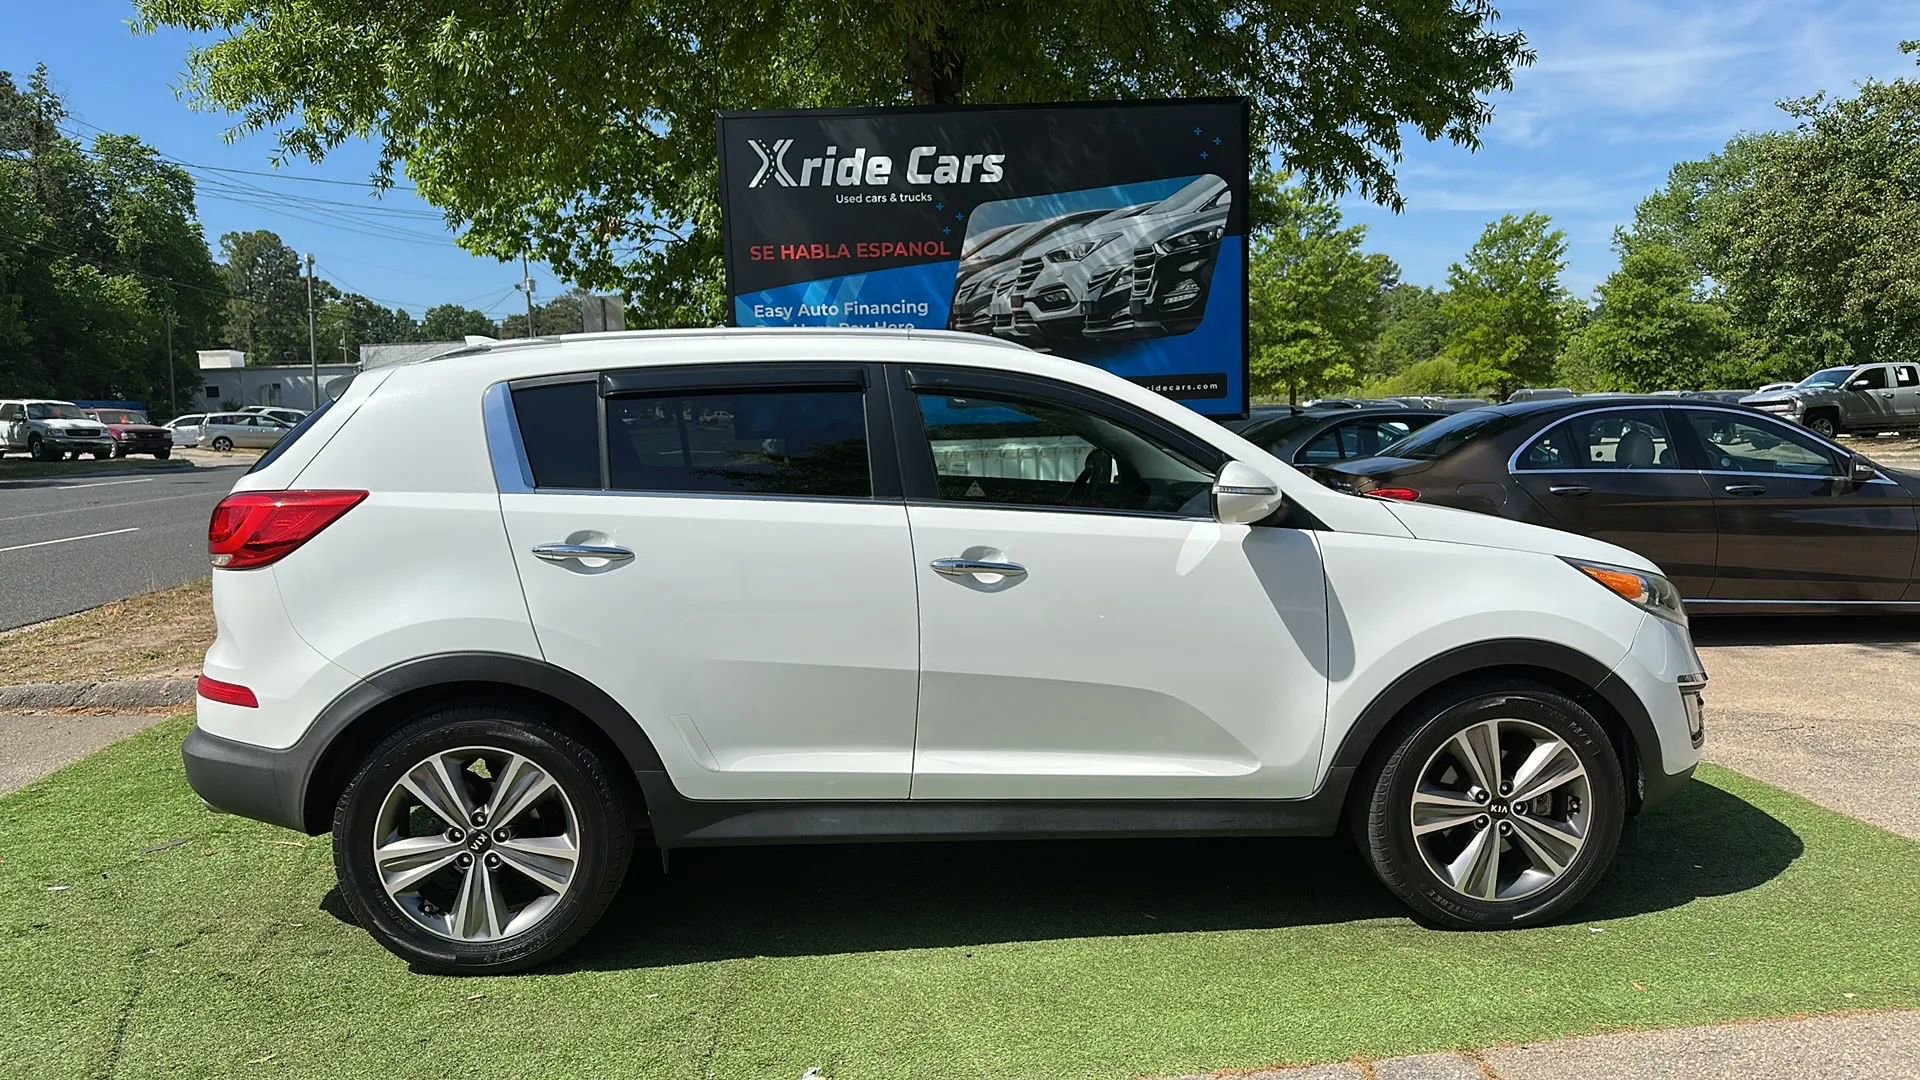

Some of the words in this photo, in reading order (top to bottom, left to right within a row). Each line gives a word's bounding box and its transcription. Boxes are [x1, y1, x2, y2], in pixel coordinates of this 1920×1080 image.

[906, 146, 1006, 185] Cars
[836, 194, 863, 204] Used
[865, 195, 887, 203] cars
[889, 194, 898, 203] &
[899, 192, 933, 202] trucks
[750, 245, 775, 261] SE
[780, 244, 851, 261] HABLA
[856, 241, 951, 258] ESPANOL
[754, 304, 793, 320] Easy
[797, 303, 839, 317] Auto
[843, 299, 929, 317] Financing
[1490, 804, 1508, 814] KIA
[470, 833, 488, 851] KIA
